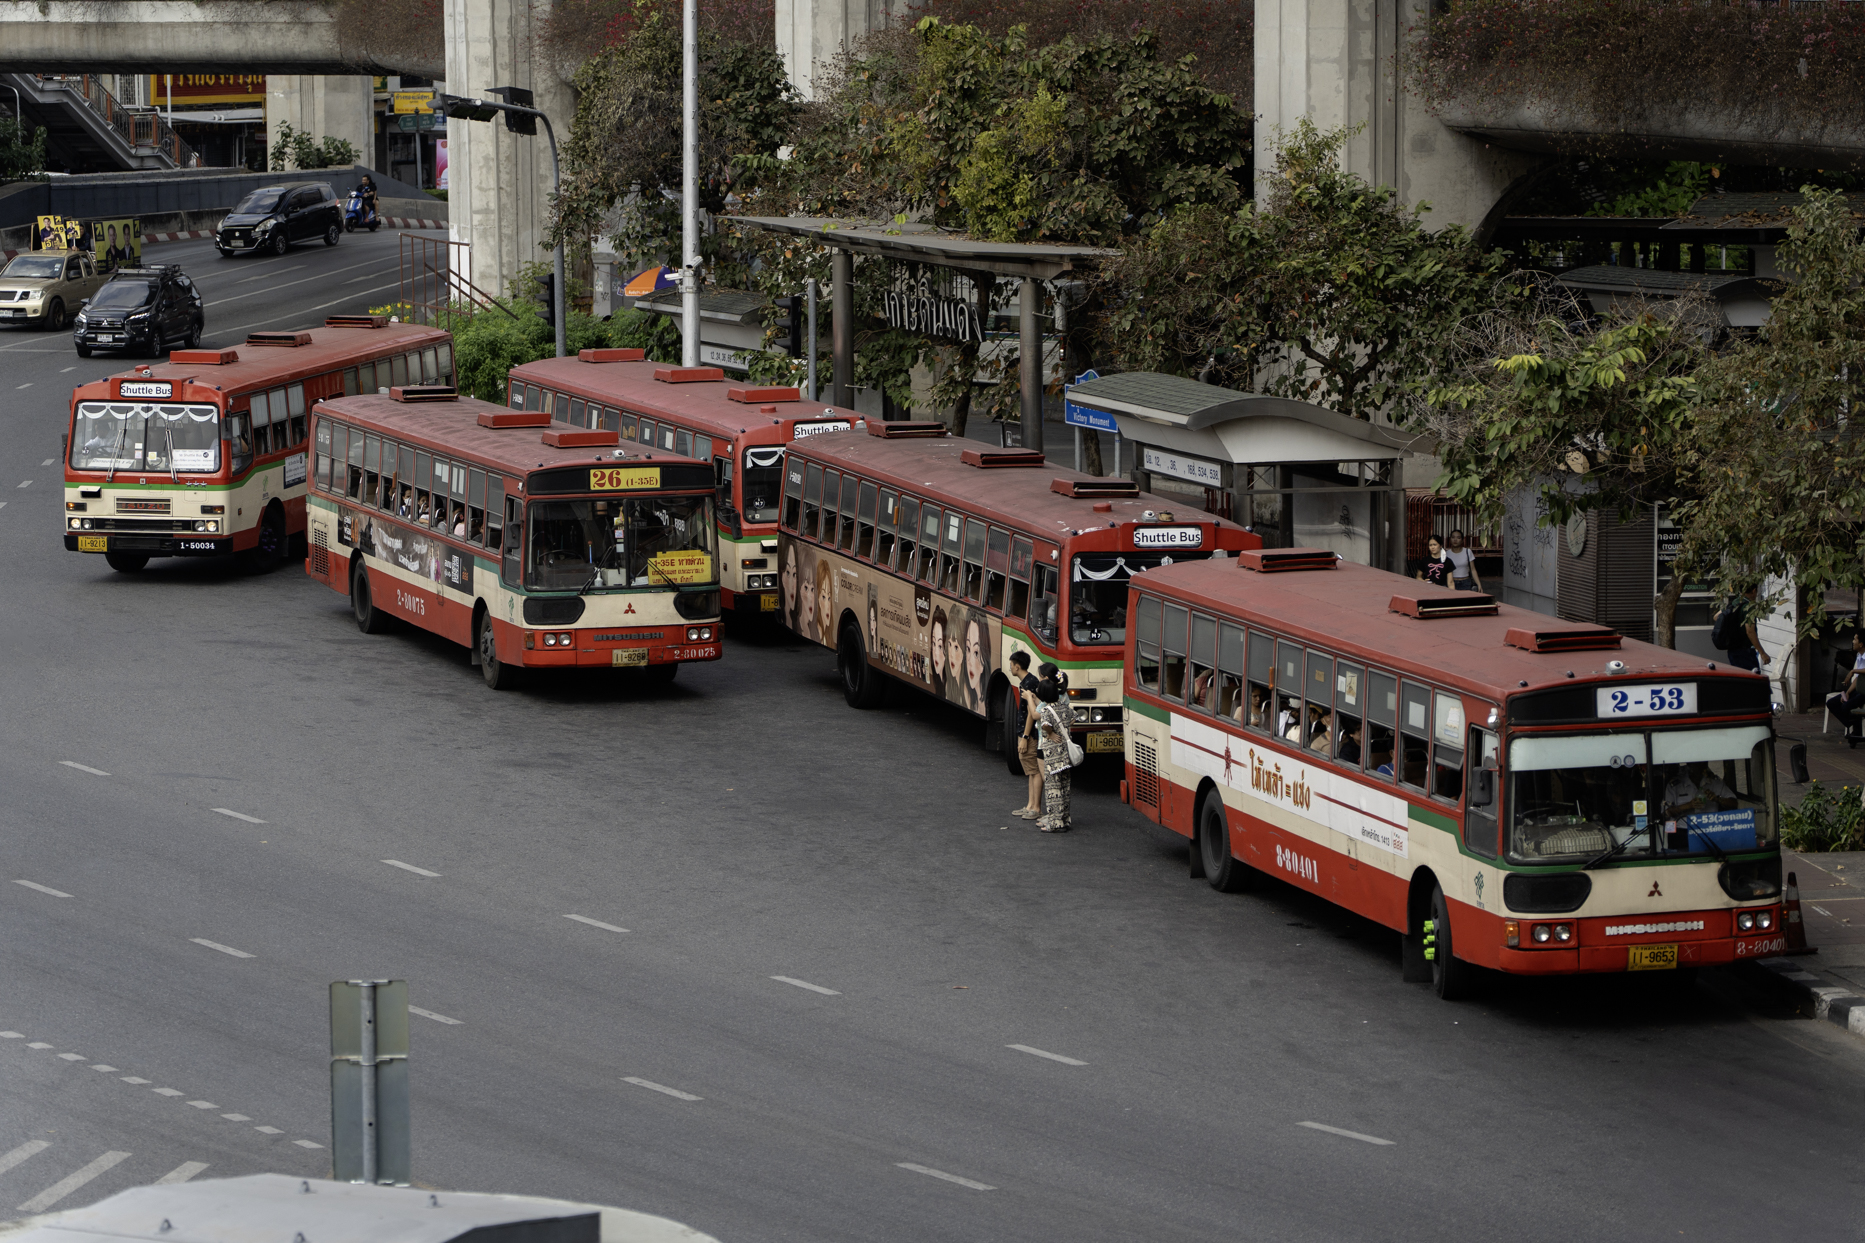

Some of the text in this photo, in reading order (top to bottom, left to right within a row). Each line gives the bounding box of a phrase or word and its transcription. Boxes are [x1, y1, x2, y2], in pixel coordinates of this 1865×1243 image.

[121, 385, 172, 395] Shuttle Bus
[1073, 412, 1110, 427] Victory Monument
[592, 469, 659, 488] 26 (1-35E)
[80, 539, 106, 548] 11-9213
[1134, 531, 1201, 543] Shuttle Bus
[397, 589, 425, 616] 2-80075
[594, 632, 664, 641] MITSUBISHI
[674, 647, 716, 659] 2-80075
[1090, 737, 1124, 747] 11-9606
[1381, 834, 1391, 847] 1413
[1276, 844, 1319, 883] 8-80401
[1605, 920, 1705, 936] MITSUBISHI
[1737, 938, 1786, 955] 8-80401
[1633, 950, 1675, 964] 11-9653
